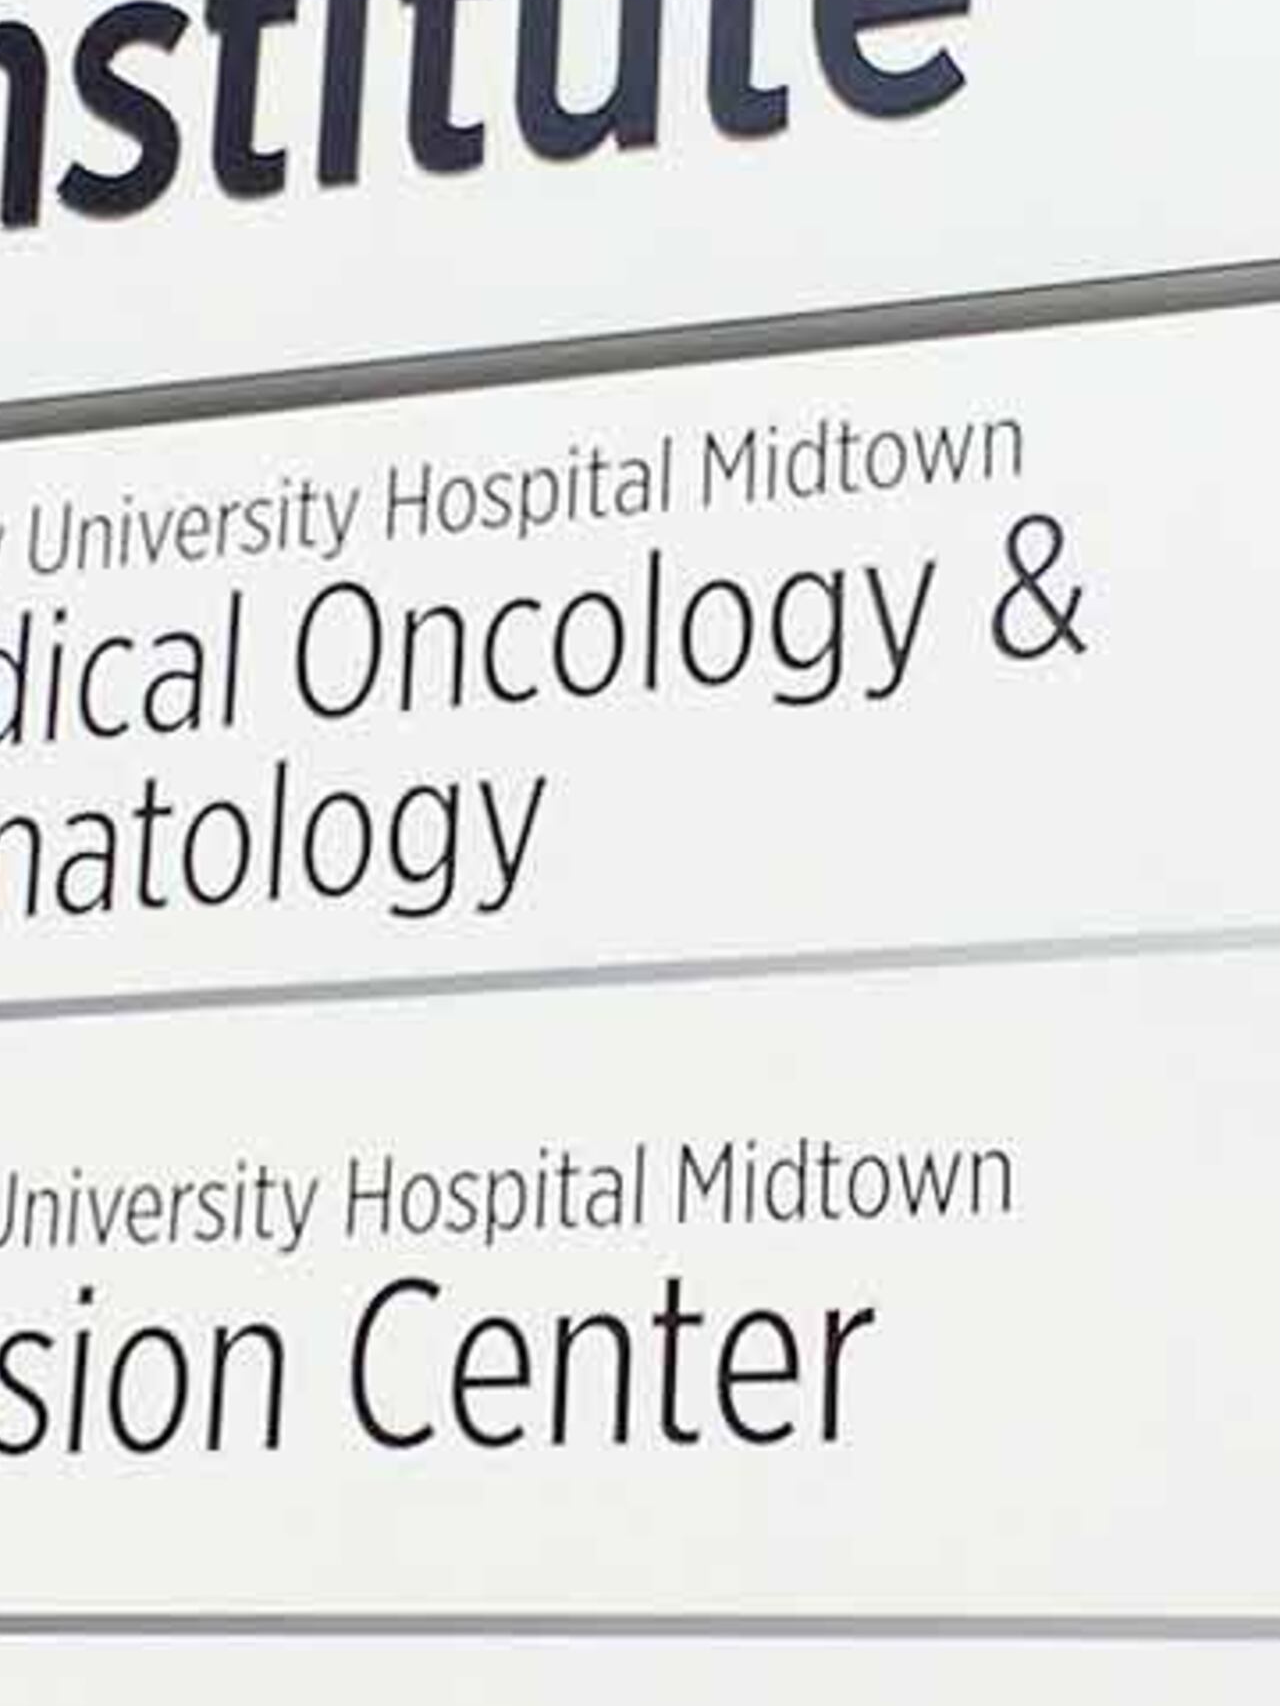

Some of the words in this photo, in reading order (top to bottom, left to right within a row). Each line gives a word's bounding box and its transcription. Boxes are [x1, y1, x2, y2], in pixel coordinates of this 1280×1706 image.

[29, 481, 359, 575] University
[387, 436, 672, 540] Hospital
[703, 419, 1022, 507] Midtown
[295, 548, 936, 720] Oncology
[991, 513, 1088, 661] &
[346, 1143, 645, 1247] Hospital
[678, 1137, 1011, 1223] Midtown
[351, 1276, 876, 1450] Center
